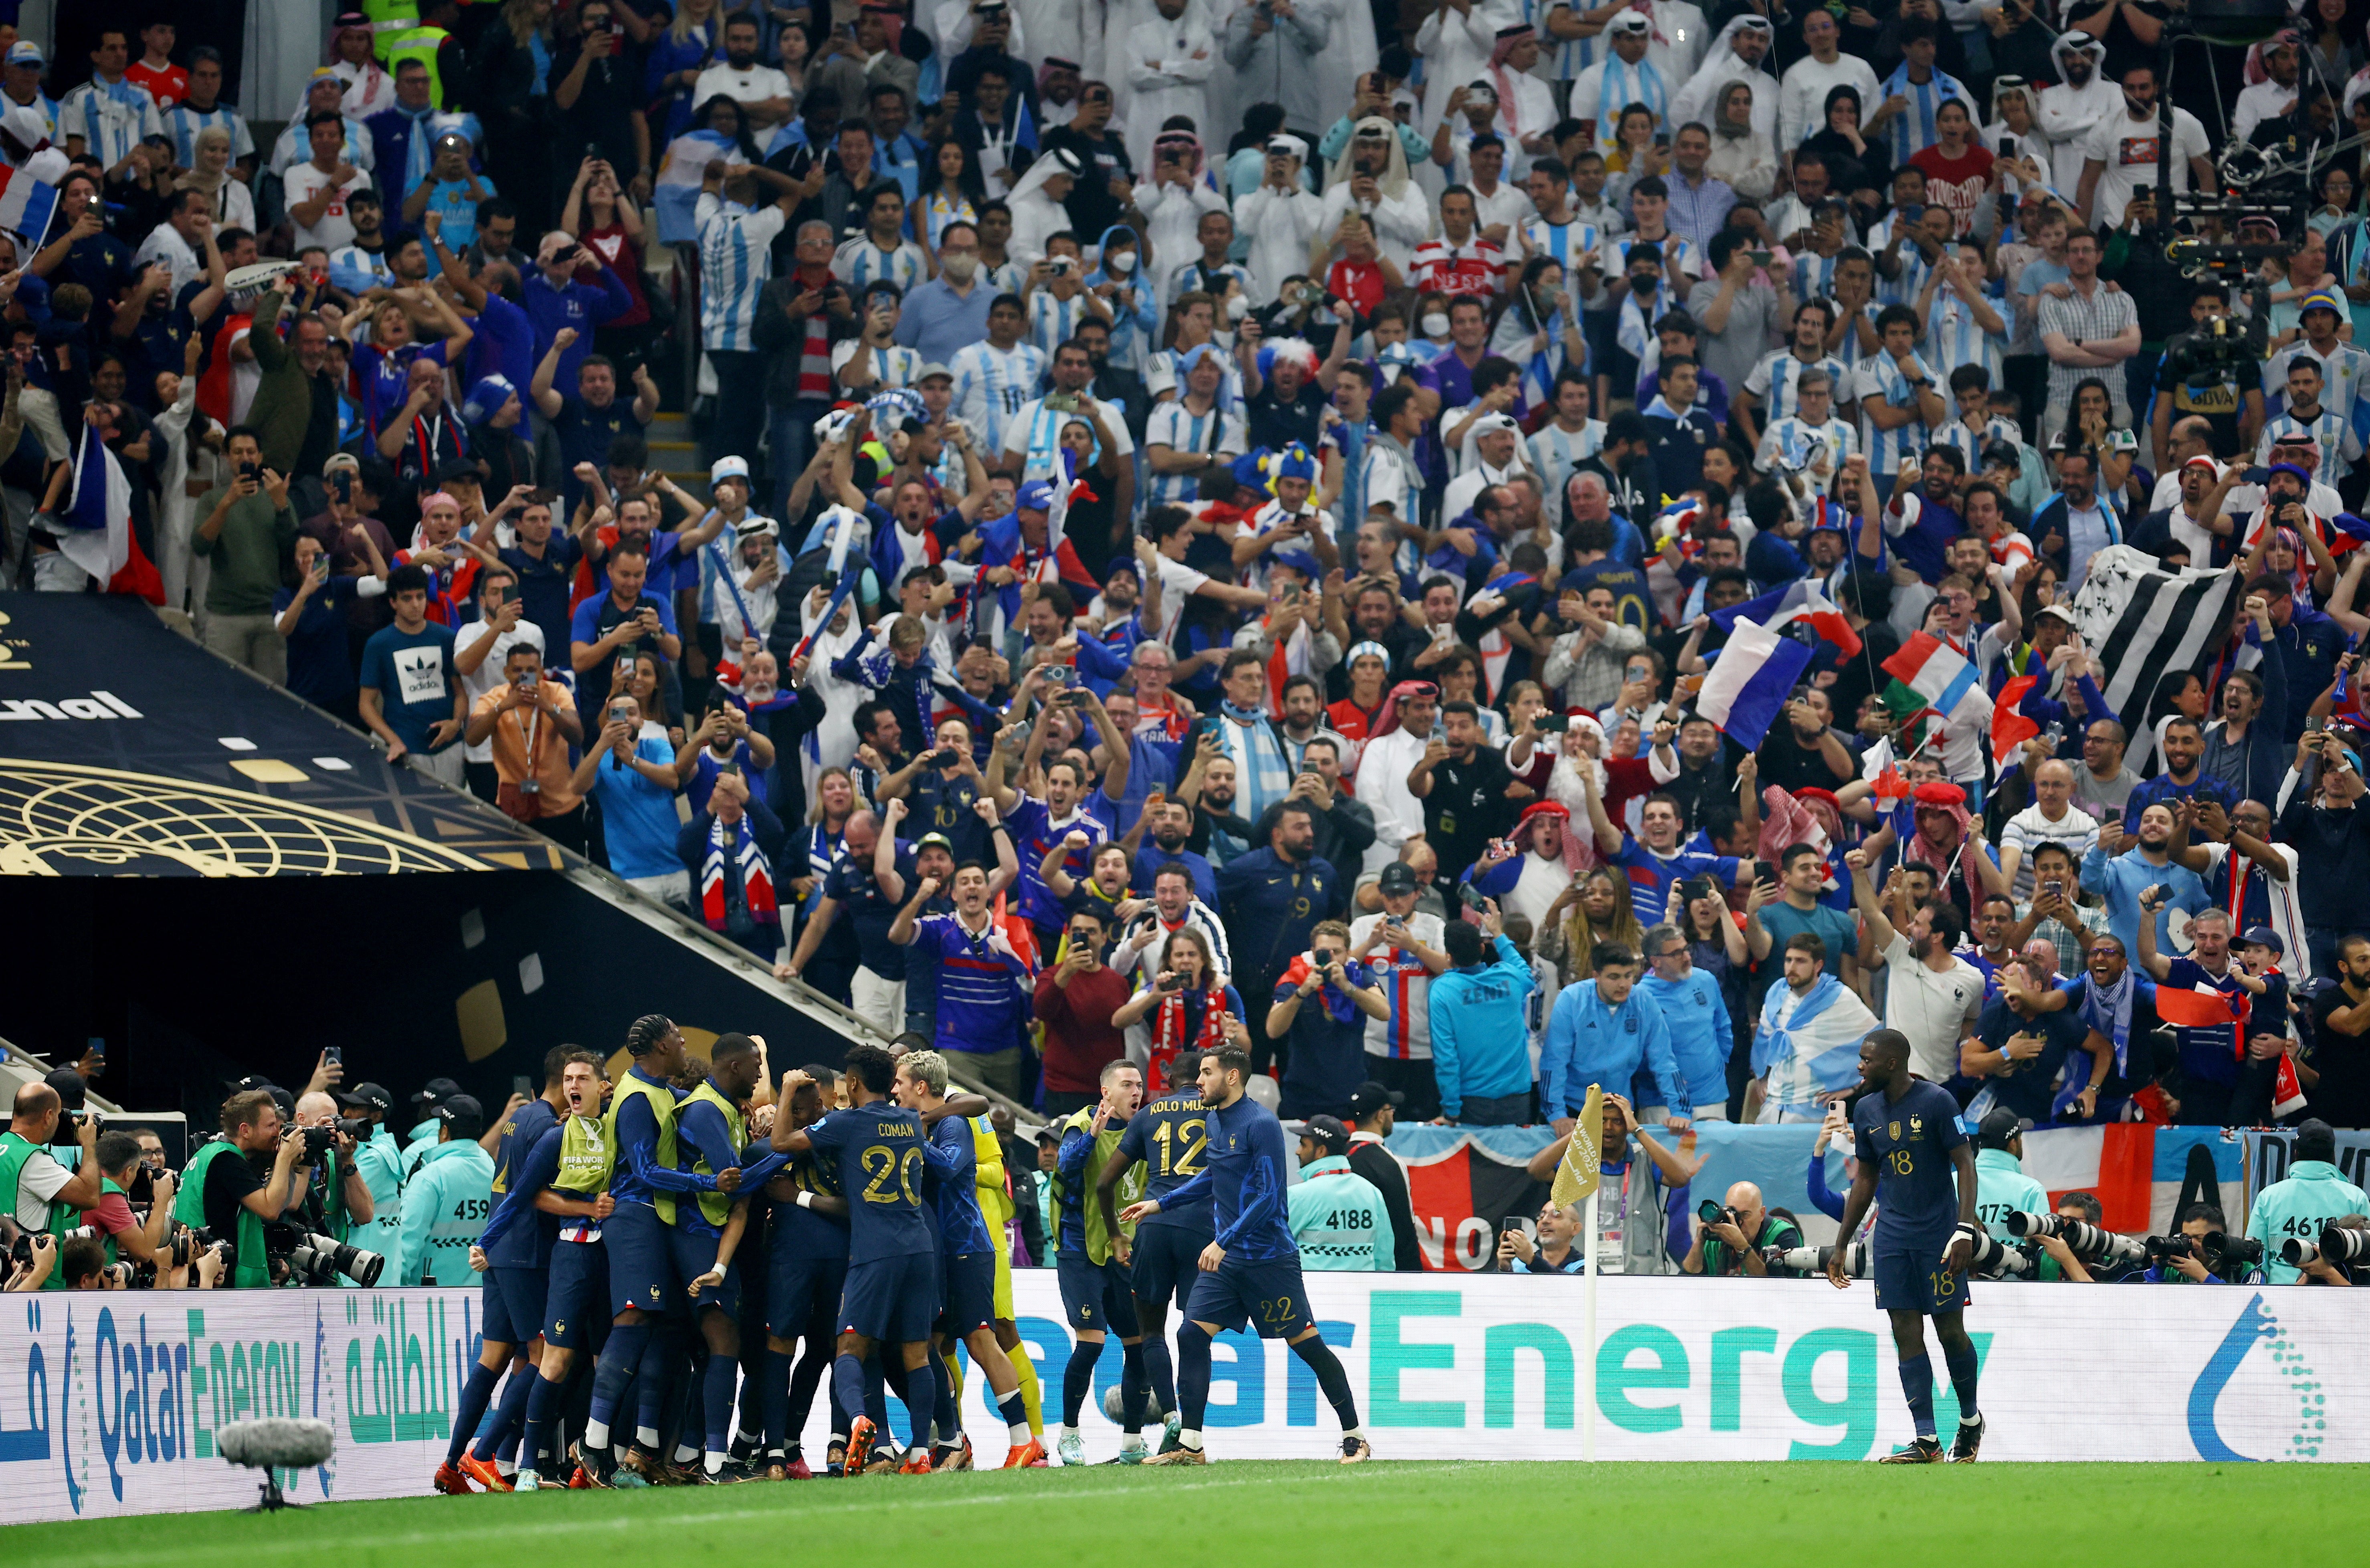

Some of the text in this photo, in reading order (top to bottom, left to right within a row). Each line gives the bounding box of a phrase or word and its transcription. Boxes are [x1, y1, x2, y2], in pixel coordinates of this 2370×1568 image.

[409, 681, 439, 692] adidas
[934, 804, 957, 828] 10
[1150, 1100, 1179, 1116] KOLO
[878, 1122, 915, 1137] COMAN
[1152, 1119, 1209, 1176] 12
[1888, 1150, 1913, 1175] 18
[861, 1145, 924, 1207] 20
[454, 1199, 489, 1220] 459
[1326, 1209, 1373, 1230] 4188
[1929, 1271, 1955, 1296] 18
[1261, 1296, 1296, 1323] 22
